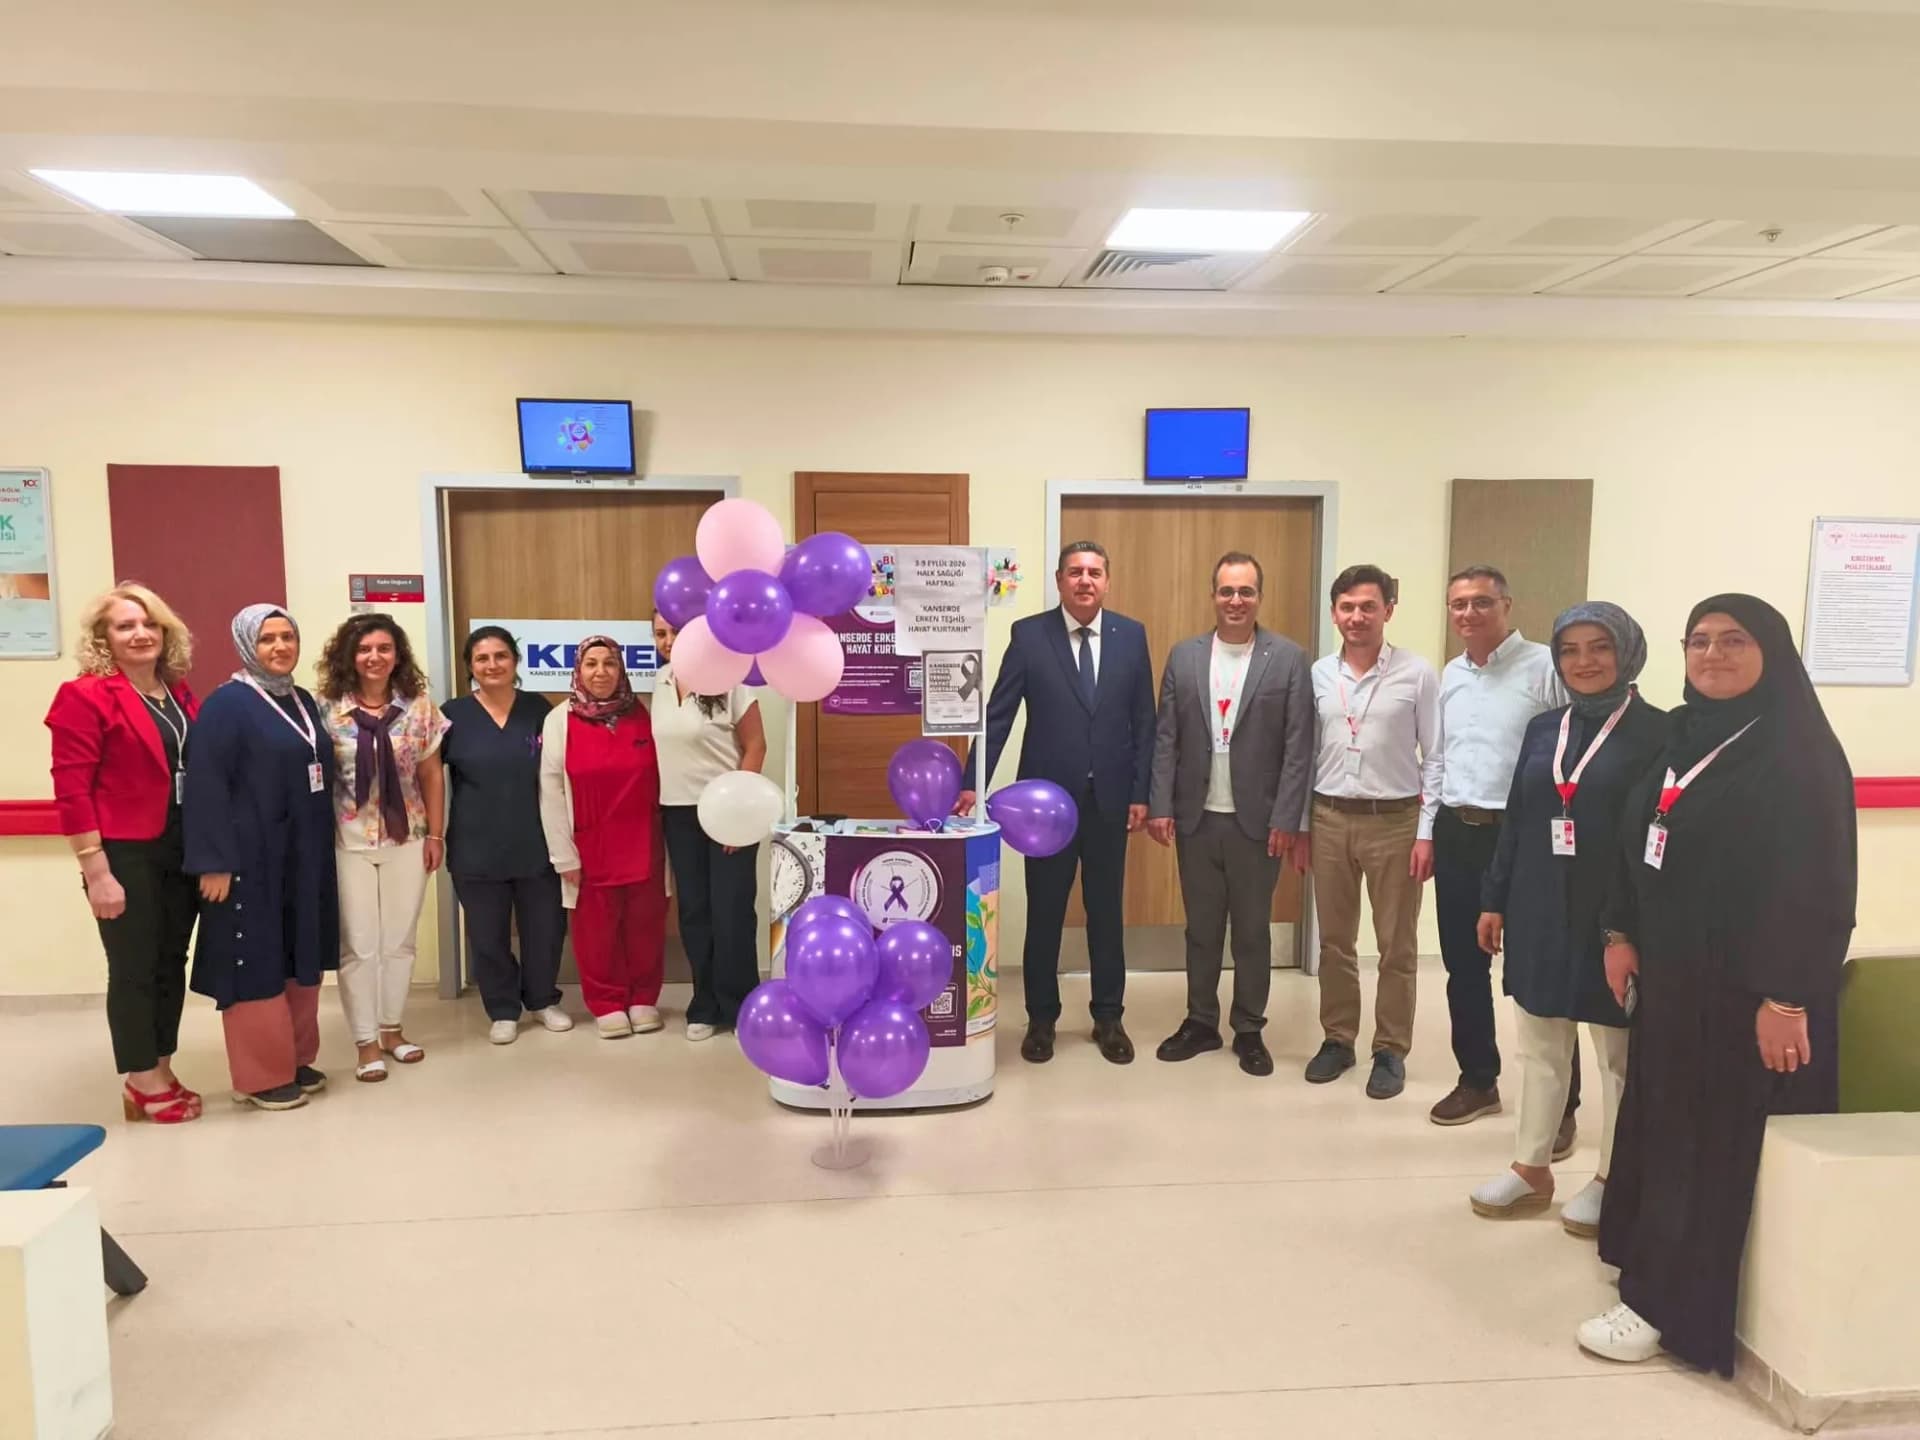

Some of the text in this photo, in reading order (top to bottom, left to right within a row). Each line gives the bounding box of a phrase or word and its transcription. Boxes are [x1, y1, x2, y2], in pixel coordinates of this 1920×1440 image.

[915, 615, 939, 623] ERKEN
[908, 625, 931, 633] HAYAT
[839, 632, 896, 643] NSERDE ERKE
[846, 643, 896, 655] HAYAT KURT
